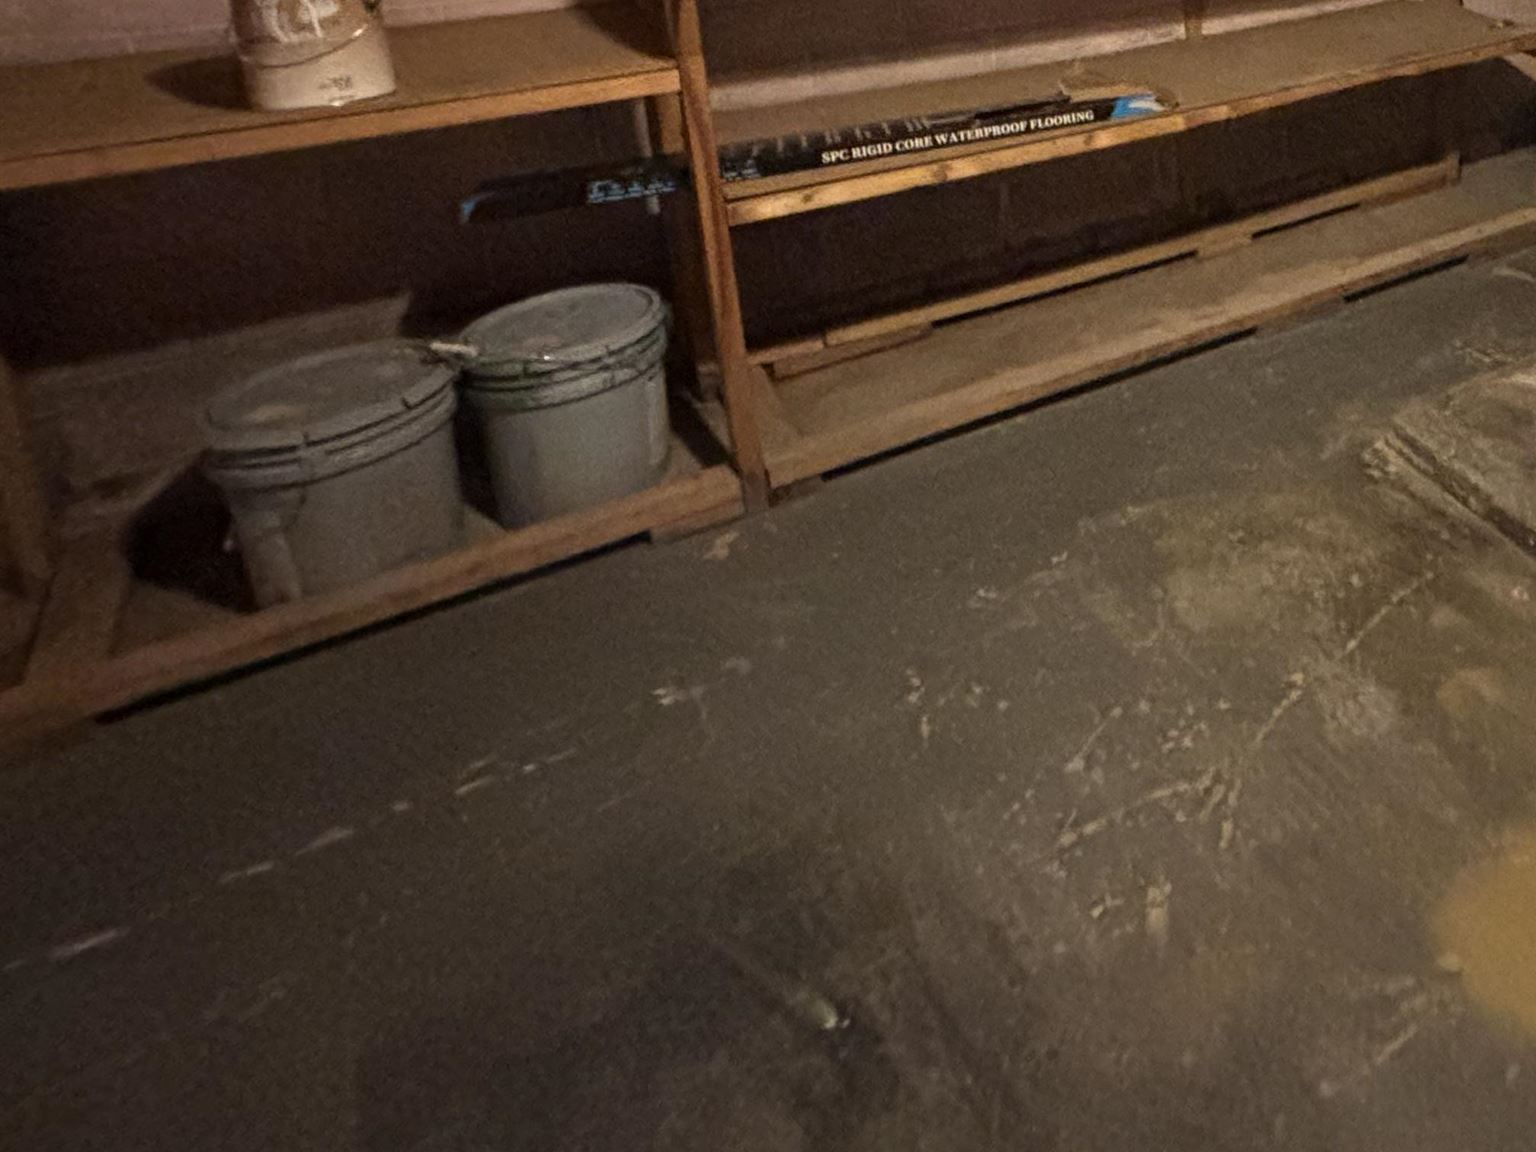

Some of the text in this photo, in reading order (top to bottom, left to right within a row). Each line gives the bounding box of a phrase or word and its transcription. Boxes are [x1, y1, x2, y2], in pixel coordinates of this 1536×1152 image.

[821, 110, 1095, 165] SPC RIGID CORE WATERPROOF FLOORING
